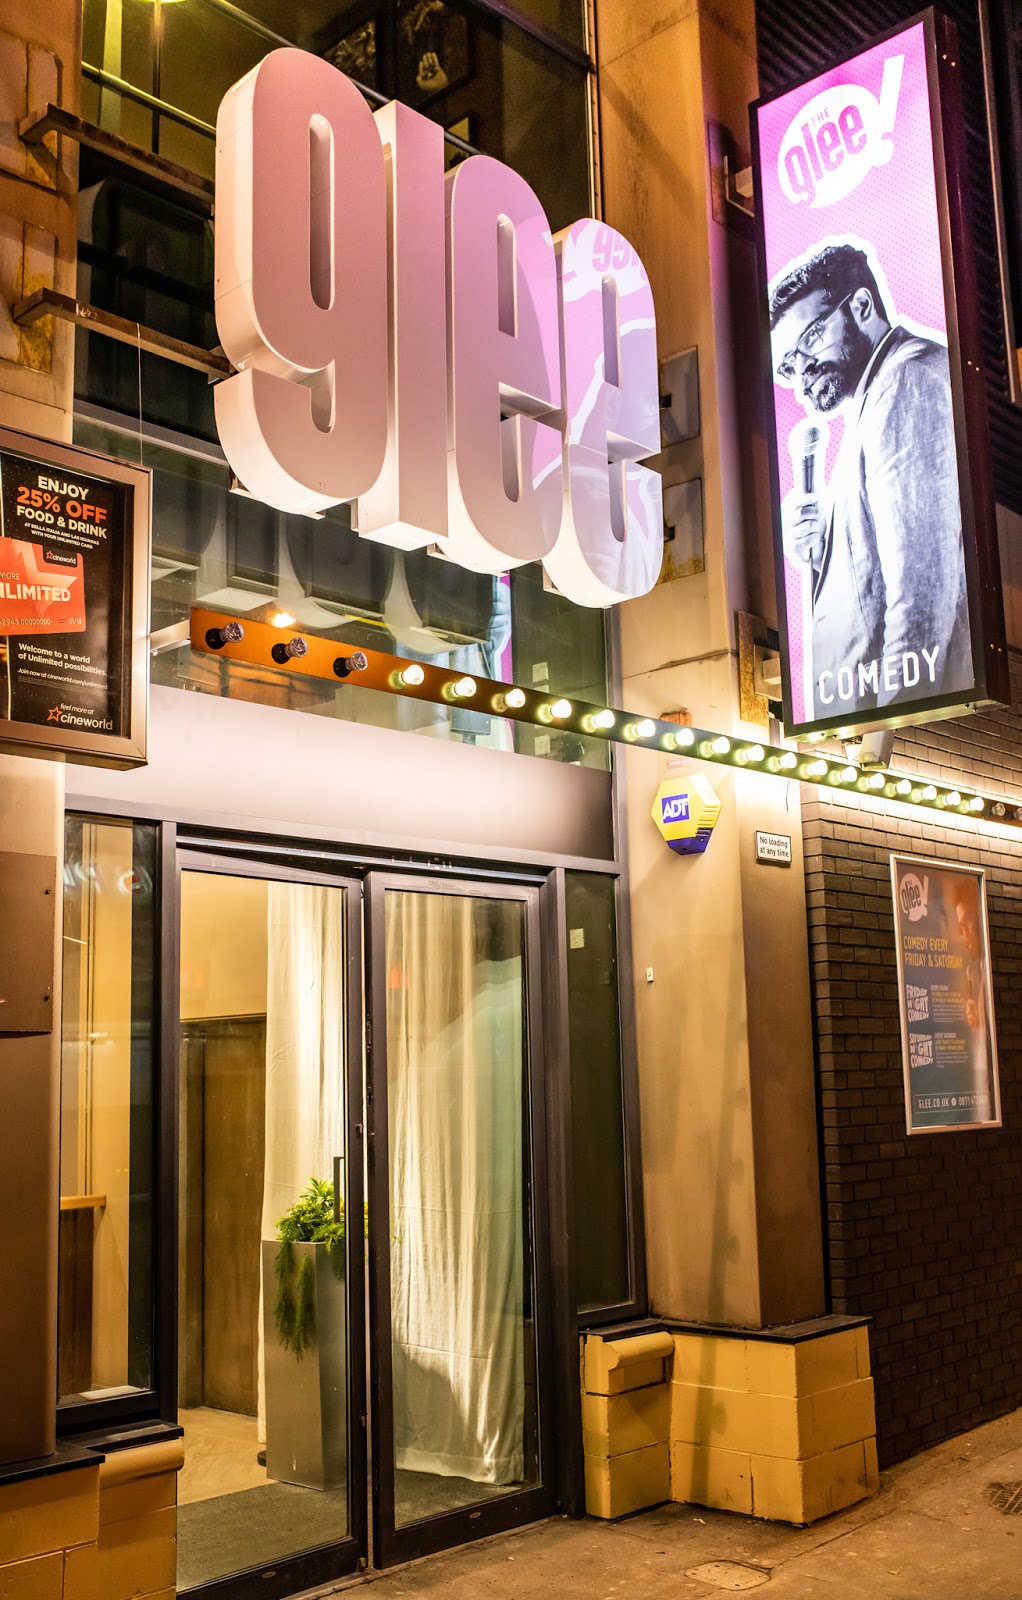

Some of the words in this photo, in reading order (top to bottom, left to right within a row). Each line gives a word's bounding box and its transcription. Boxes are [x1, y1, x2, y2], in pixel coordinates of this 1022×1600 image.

[811, 106, 830, 128] THE
[214, 47, 663, 607] glee
[38, 475, 89, 500] ENJOY
[17, 486, 60, 512] 25%
[66, 500, 107, 524] OFF
[17, 505, 54, 524] FOOD
[57, 517, 66, 528] &
[68, 519, 107, 539] DRINK
[52, 554, 76, 564] cineworld
[0, 583, 71, 602] NLIMITED
[18, 643, 53, 656] Welcome
[54, 650, 62, 658] to
[70, 655, 90, 664] world
[28, 655, 63, 668] Unlimited
[818, 645, 940, 705] COMEDY
[60, 703, 71, 711] feel
[60, 713, 113, 730] cineworld
[663, 799, 689, 819] ADT
[760, 836, 768, 844] No
[769, 837, 788, 850] loading
[766, 849, 776, 857] any
[777, 849, 789, 858] time
[904, 936, 928, 950] COMEDY
[930, 938, 948, 952] EVERY
[905, 952, 926, 966] FRIDAY
[928, 954, 933, 967] &
[935, 954, 963, 968] SATURDAY
[906, 984, 928, 1000] FRIDAY
[908, 1010, 929, 1023] COMEDY
[909, 1033, 932, 1044] SATURDAY
[911, 1054, 933, 1069] COMEDY
[918, 1098, 949, 1109] GLEE.CO.UK
